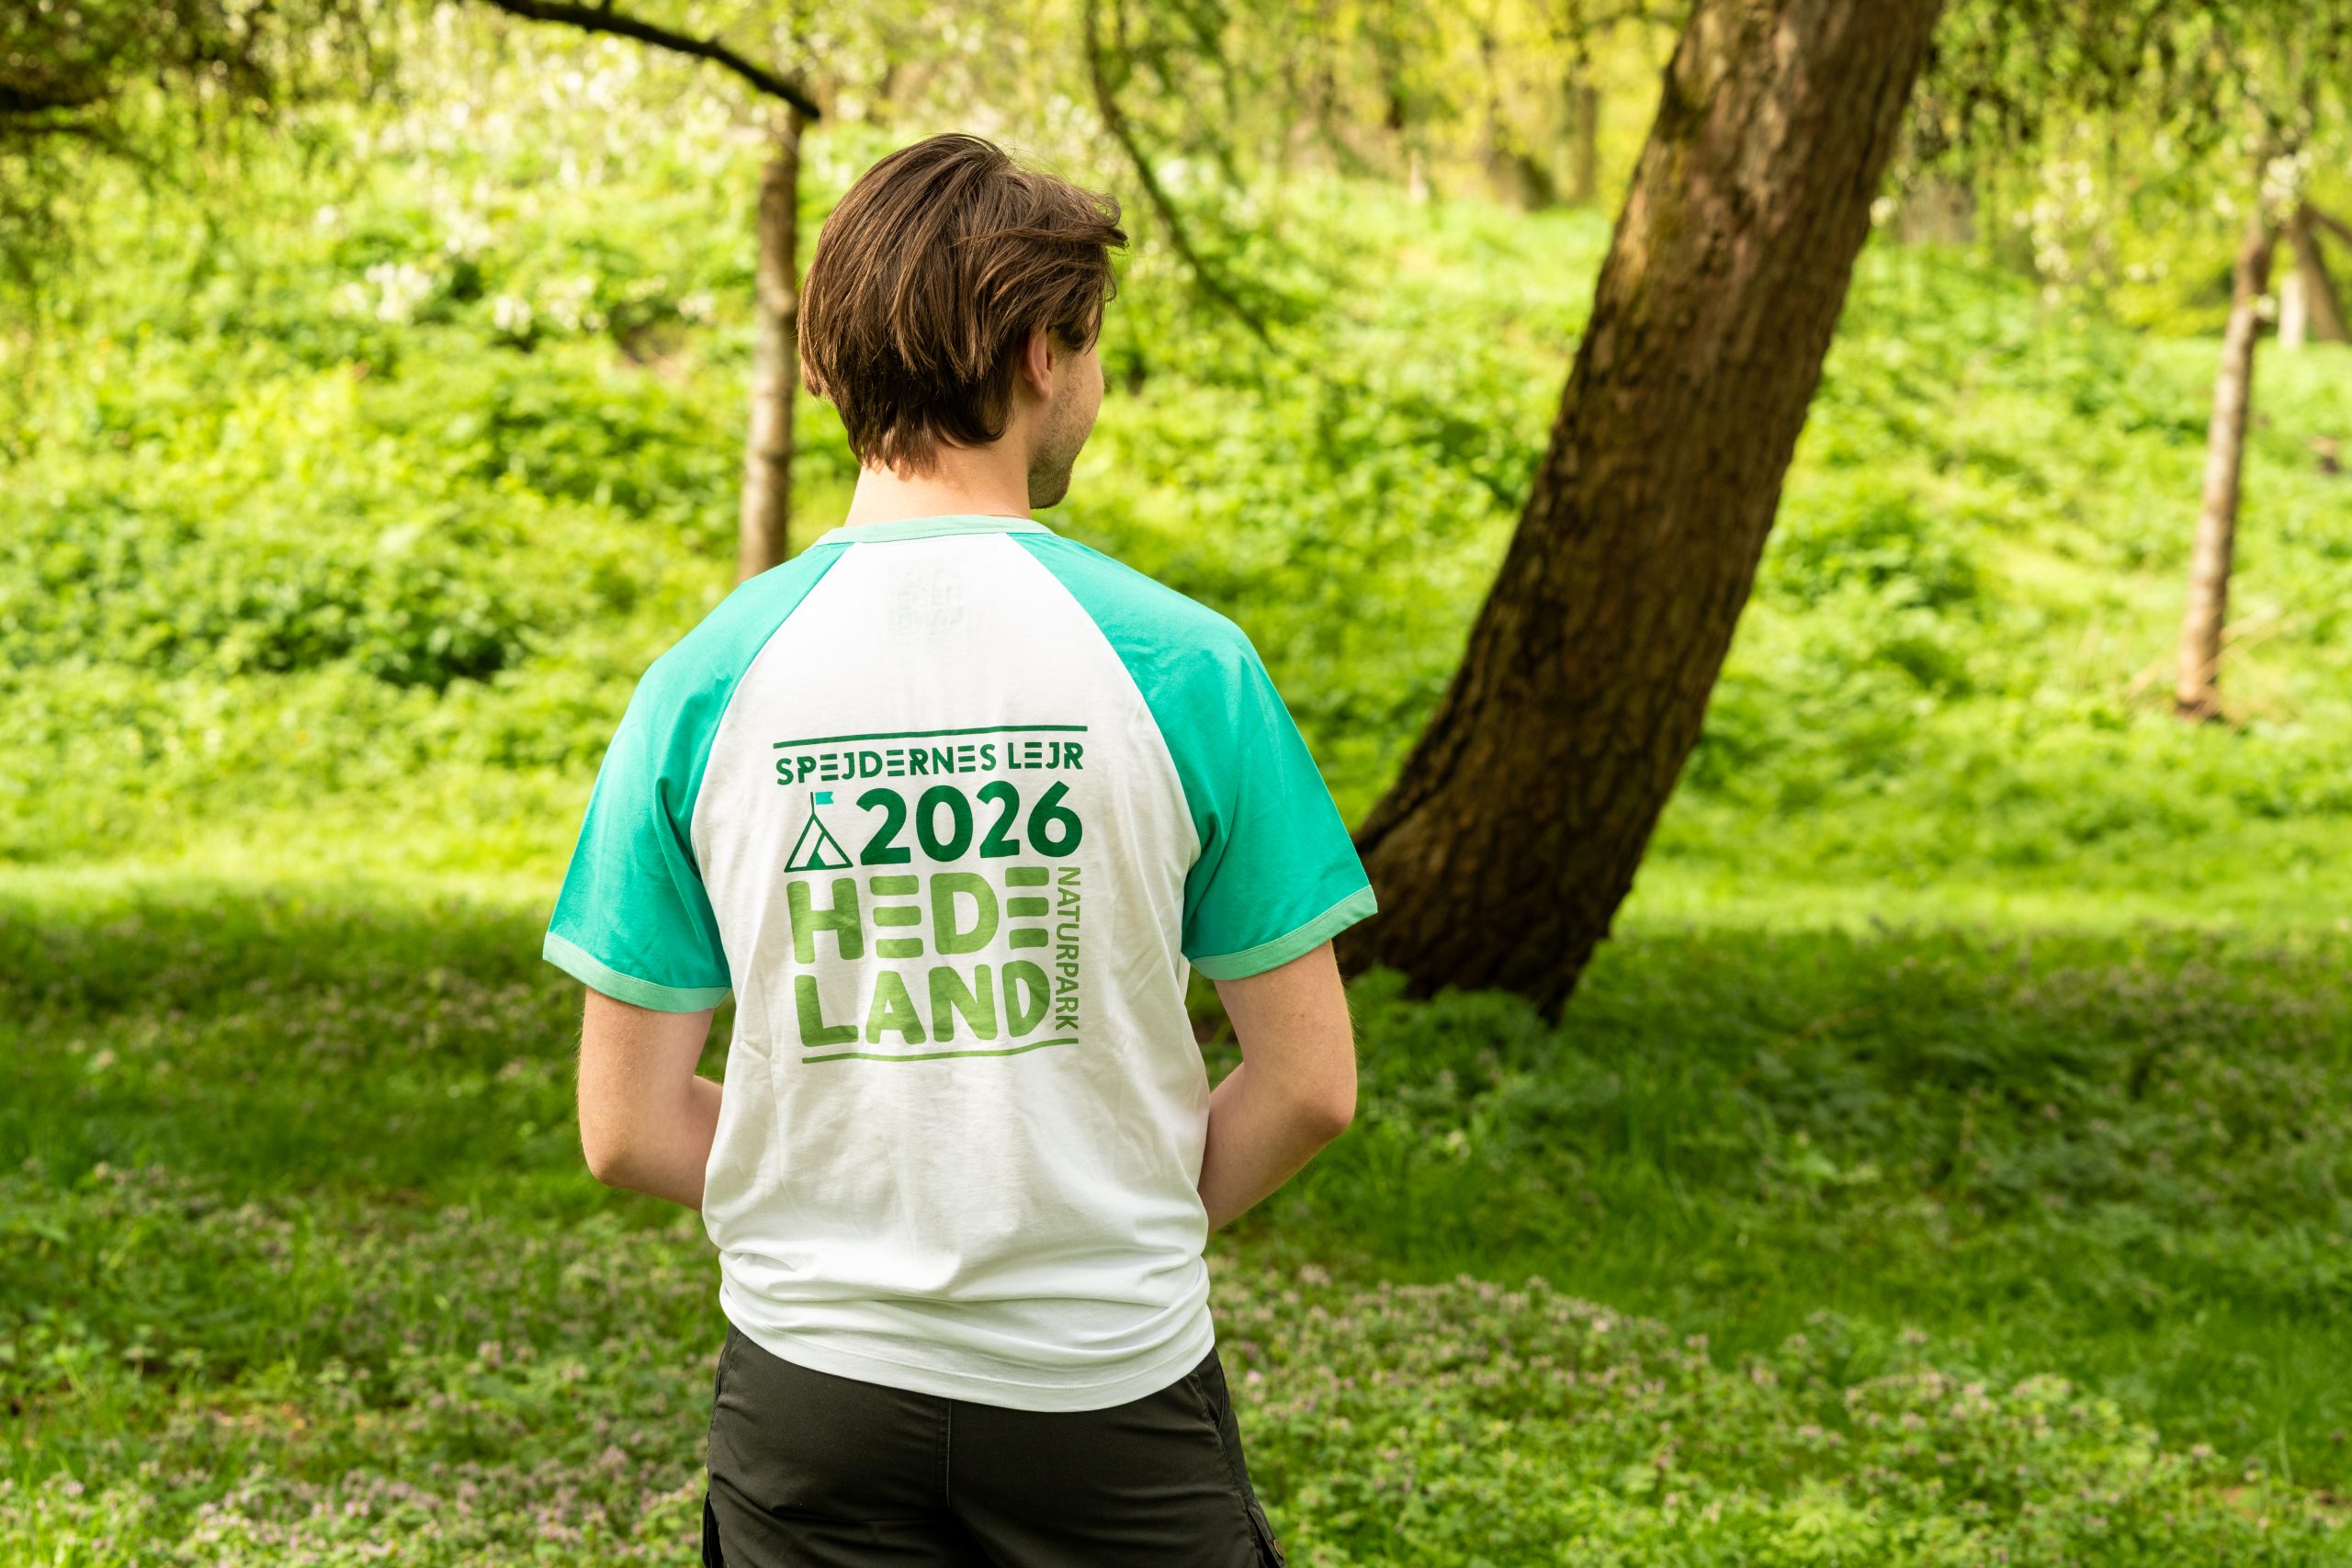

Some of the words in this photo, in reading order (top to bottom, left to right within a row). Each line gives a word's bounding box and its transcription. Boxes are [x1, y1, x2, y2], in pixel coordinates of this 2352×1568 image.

[775, 743, 996, 785] SPEJDERNES
[1007, 741, 1084, 770] LEJR
[855, 780, 1083, 865] 2026
[786, 866, 1050, 964] HEDE
[1055, 866, 1081, 1031] NATURPARK
[795, 960, 1051, 1047] LAND
